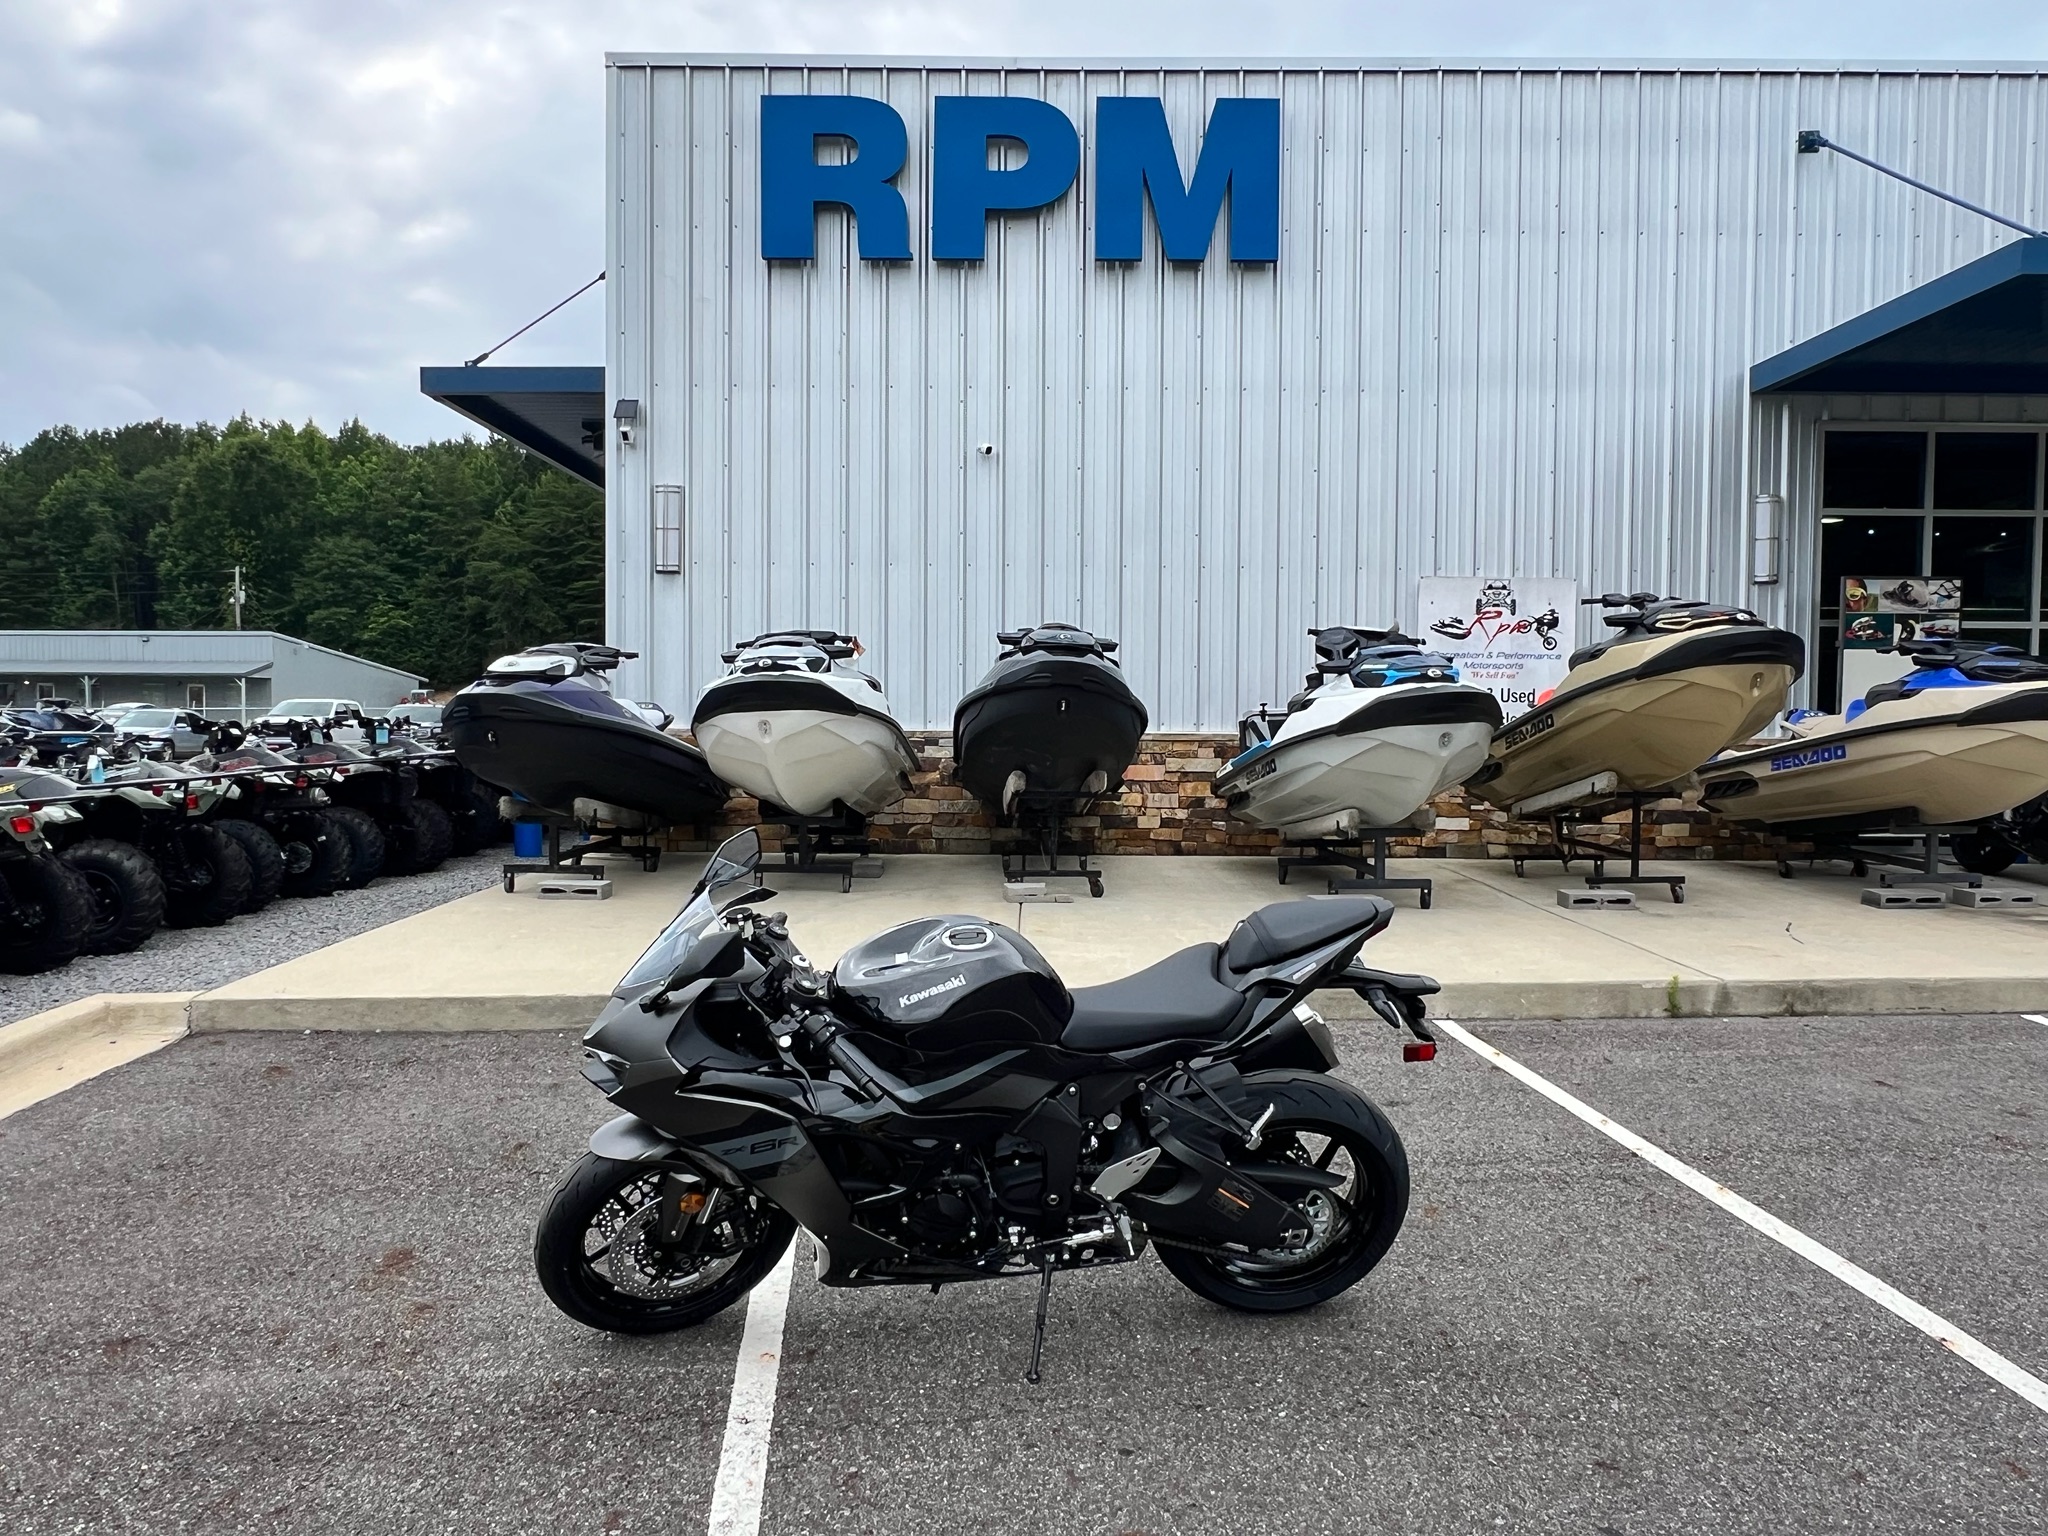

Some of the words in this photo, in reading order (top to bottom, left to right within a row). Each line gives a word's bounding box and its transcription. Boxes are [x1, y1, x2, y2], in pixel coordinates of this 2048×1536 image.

[761, 94, 1281, 262] RPM
[1486, 651, 1494, 660] &
[1496, 651, 1562, 661] Performance
[1463, 661, 1524, 671] Motorsports
[1485, 671, 1498, 679] Sell
[1500, 687, 1536, 703] Used
[898, 973, 967, 1008] Kawasaki
